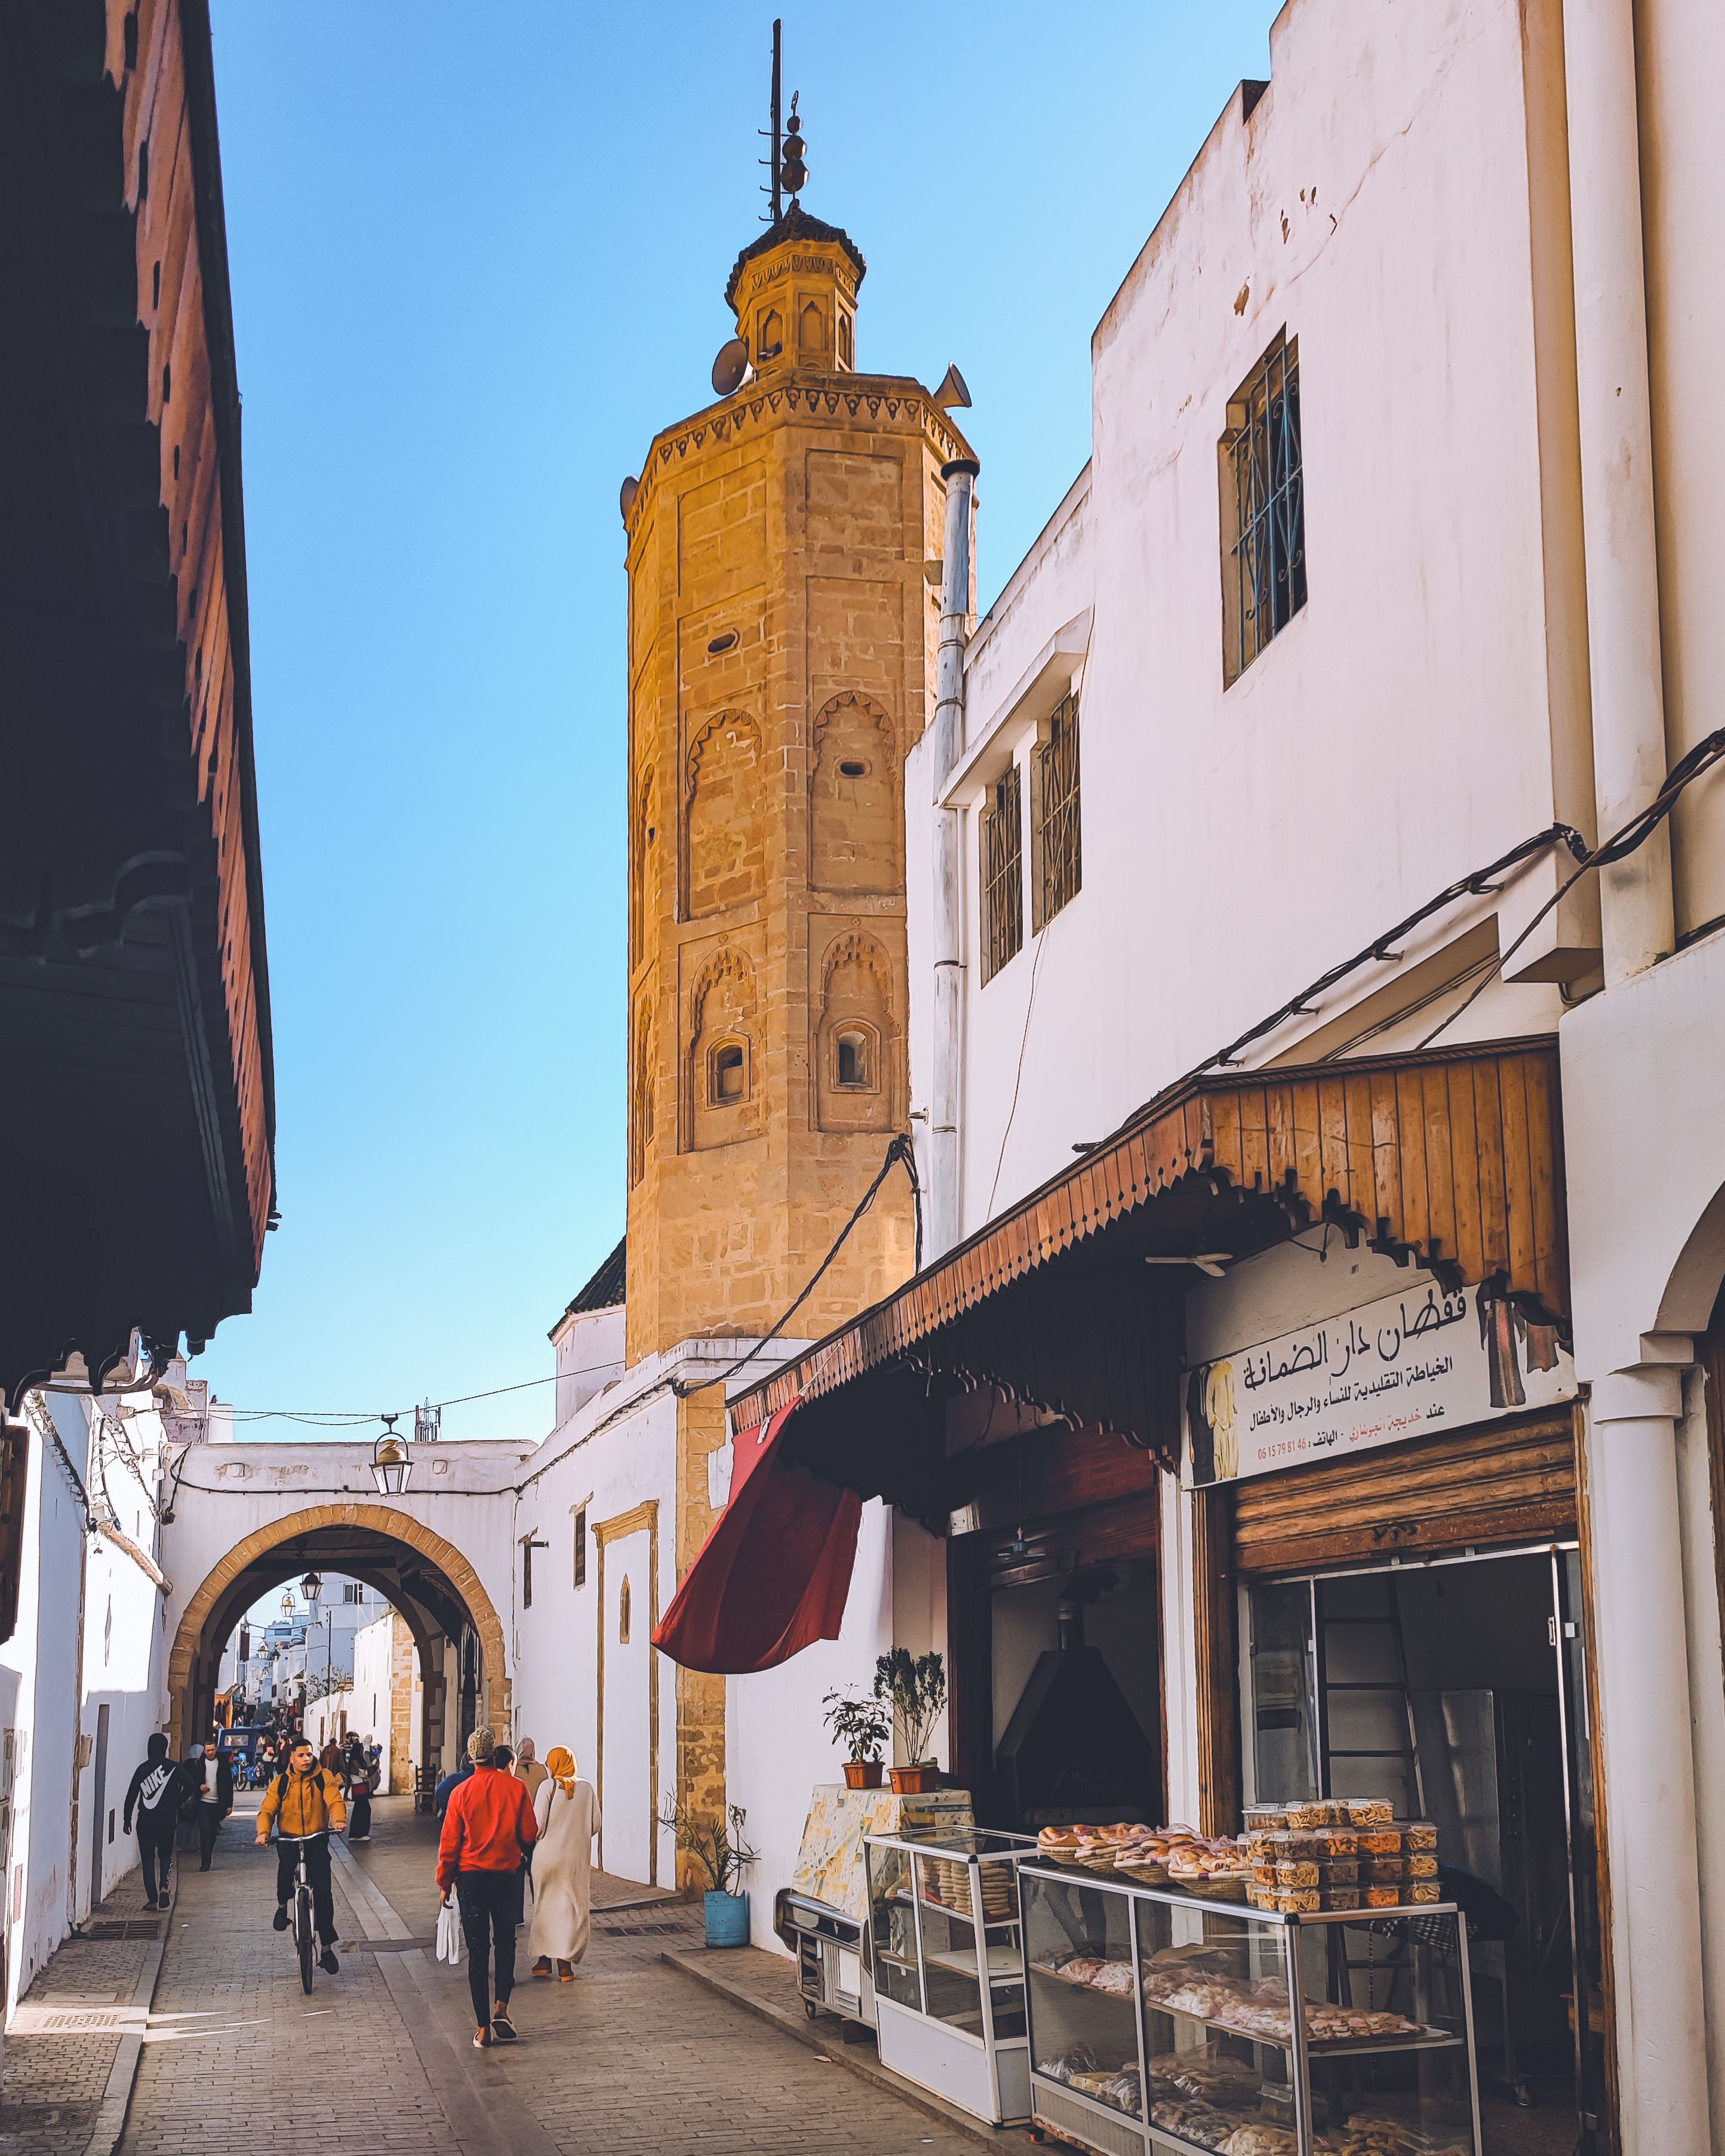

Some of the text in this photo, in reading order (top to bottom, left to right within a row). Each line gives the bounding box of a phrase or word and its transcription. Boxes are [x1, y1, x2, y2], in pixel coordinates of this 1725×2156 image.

[1243, 1288, 1466, 1391] قفطان دار الضمانة
[1406, 1355, 1453, 1387] الخياطة
[1323, 1385, 1351, 1408] للنساء
[1354, 1371, 1403, 1401] التقليدية
[1287, 1396, 1321, 1421] والرجال
[1387, 1408, 1422, 1431] خديجة
[1426, 1403, 1445, 1419] عند
[1257, 1448, 1266, 1460] 06
[1268, 1445, 1276, 1457] 15
[1277, 1443, 1286, 1455] 79
[1287, 1440, 1295, 1453] 81
[1297, 1437, 1306, 1450] 46
[140, 1764, 168, 1798] NIKE
